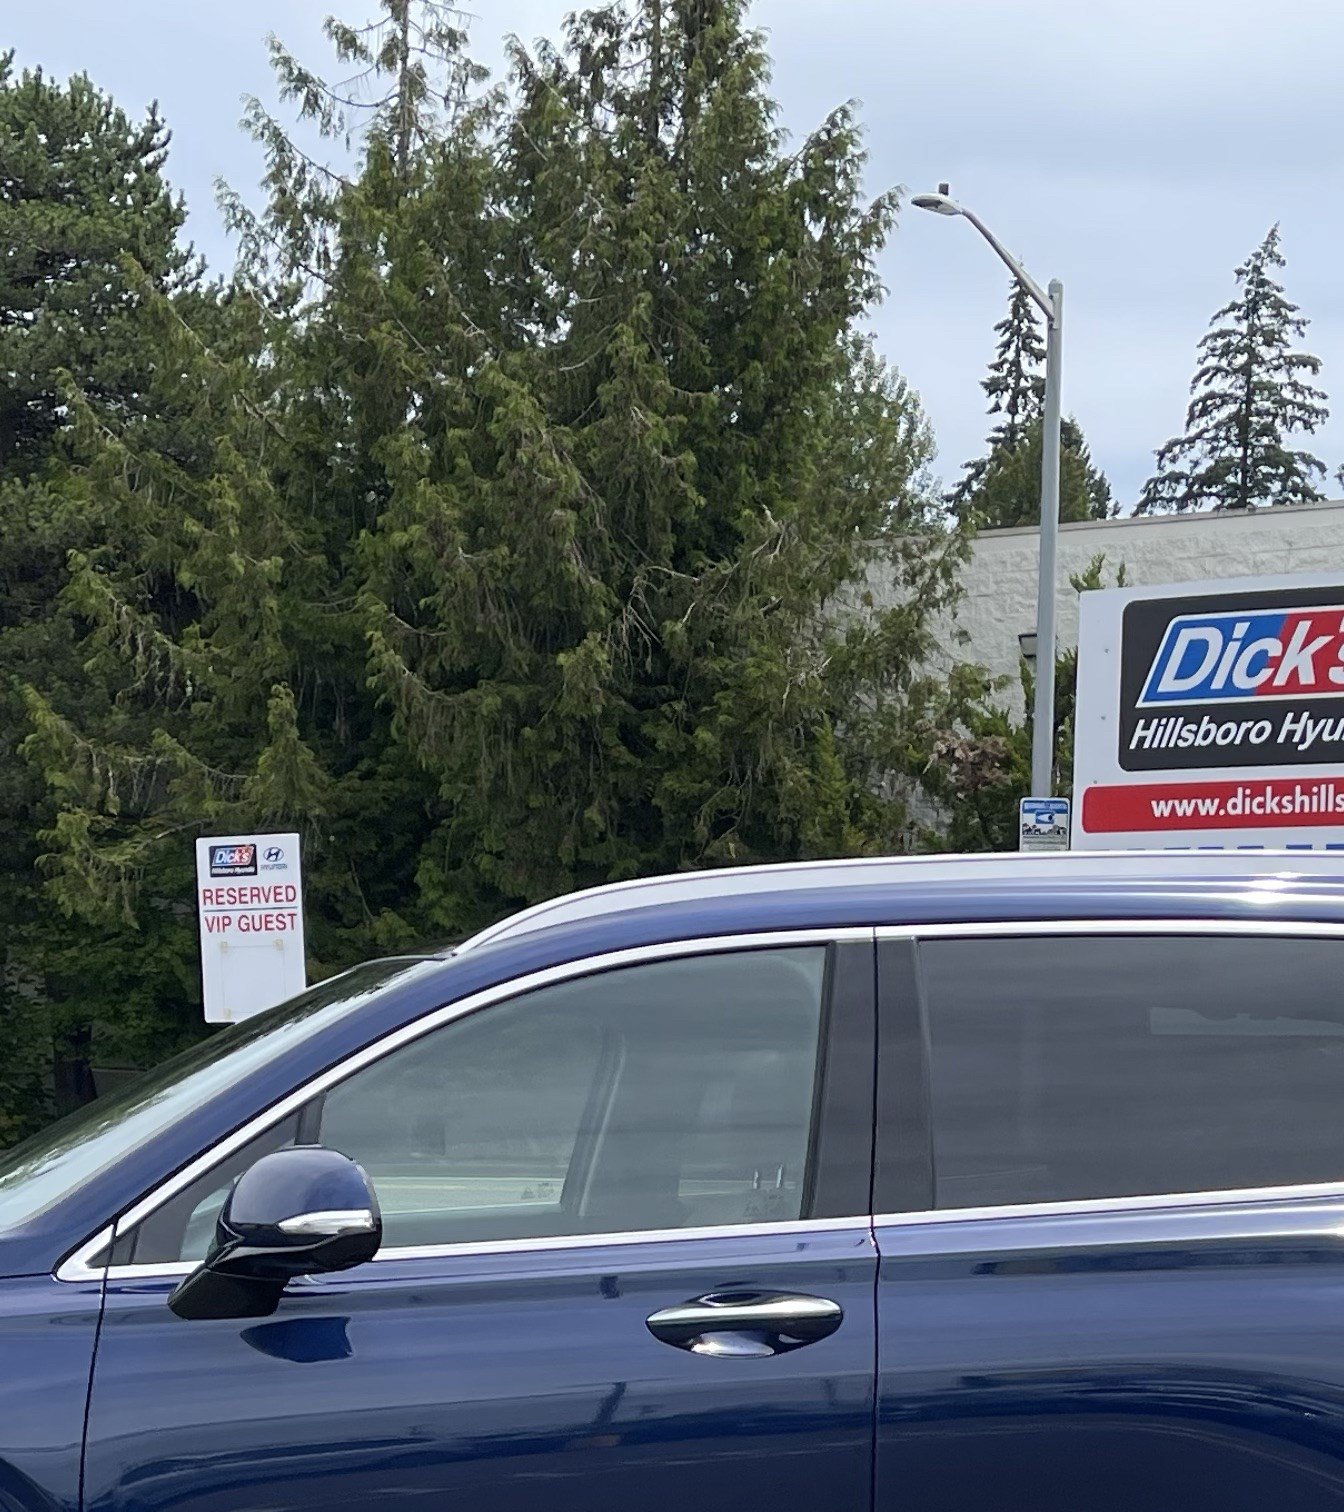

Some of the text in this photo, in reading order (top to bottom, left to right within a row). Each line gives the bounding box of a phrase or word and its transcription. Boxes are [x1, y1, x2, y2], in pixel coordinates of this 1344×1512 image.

[1129, 715, 1272, 750] Hillsboro
[202, 885, 297, 906] RESERVED
[205, 913, 298, 933] VIP GUEST
